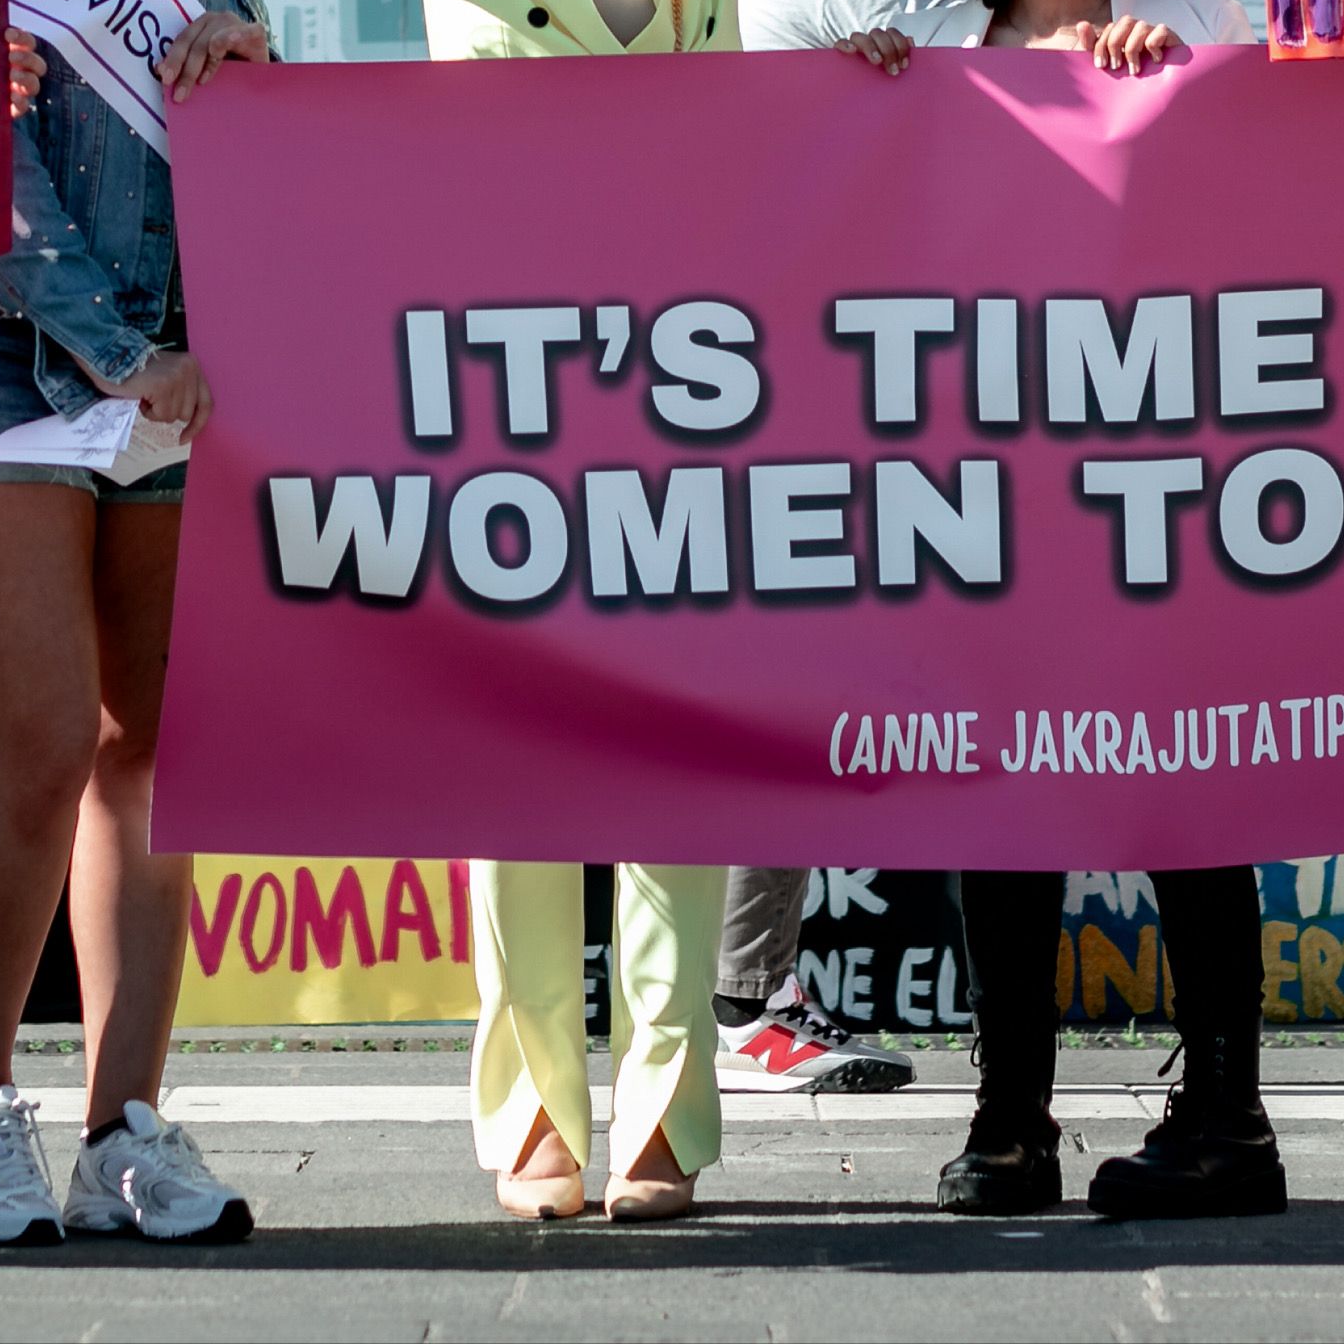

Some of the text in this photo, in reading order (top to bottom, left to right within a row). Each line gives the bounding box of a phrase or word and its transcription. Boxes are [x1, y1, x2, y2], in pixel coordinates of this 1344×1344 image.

[404, 300, 762, 438] IT'S
[834, 287, 1325, 424] TIME
[268, 459, 1004, 602] WOMEN
[829, 709, 982, 778] (ANNE
